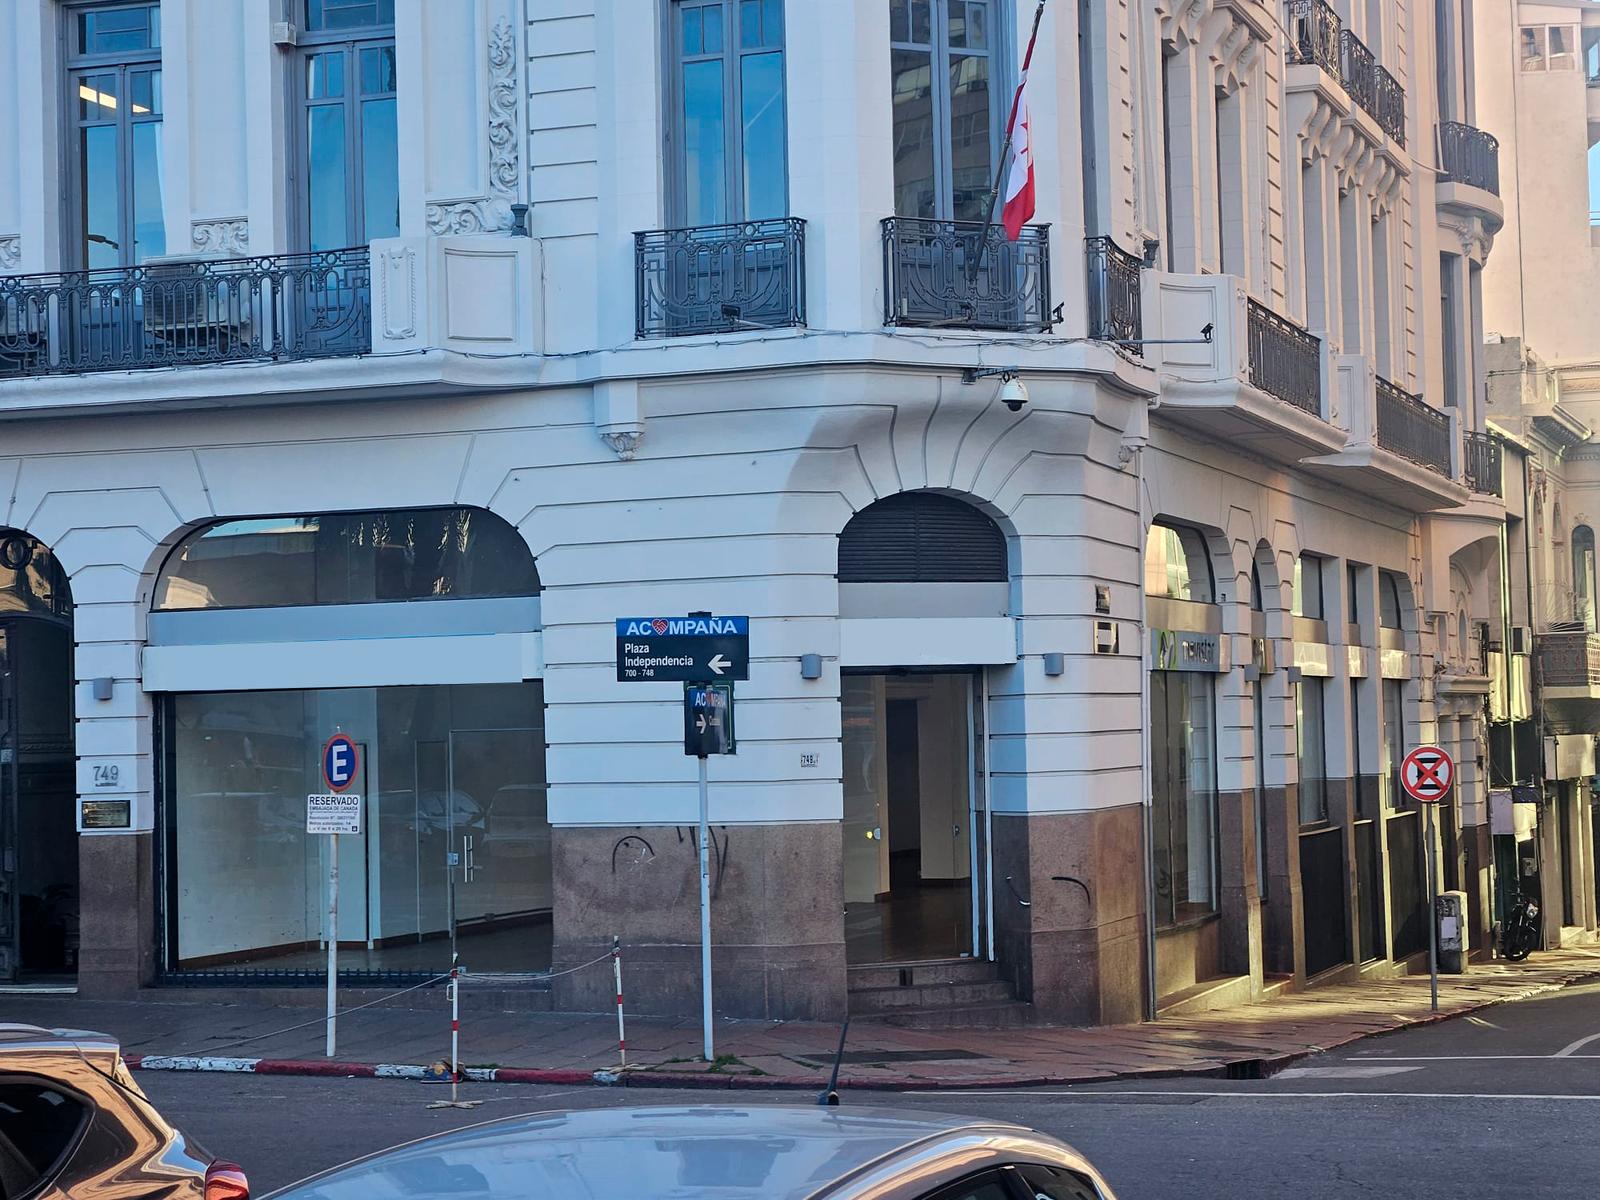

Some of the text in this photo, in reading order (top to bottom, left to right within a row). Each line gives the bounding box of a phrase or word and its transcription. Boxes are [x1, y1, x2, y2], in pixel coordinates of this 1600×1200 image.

[625, 643, 650, 653] Plaza
[625, 655, 693, 668] Independencia
[625, 669, 637, 677] 700
[642, 669, 654, 677] 748
[333, 745, 347, 781] E
[93, 765, 119, 781] 749
[309, 797, 358, 805] RESERVADO
